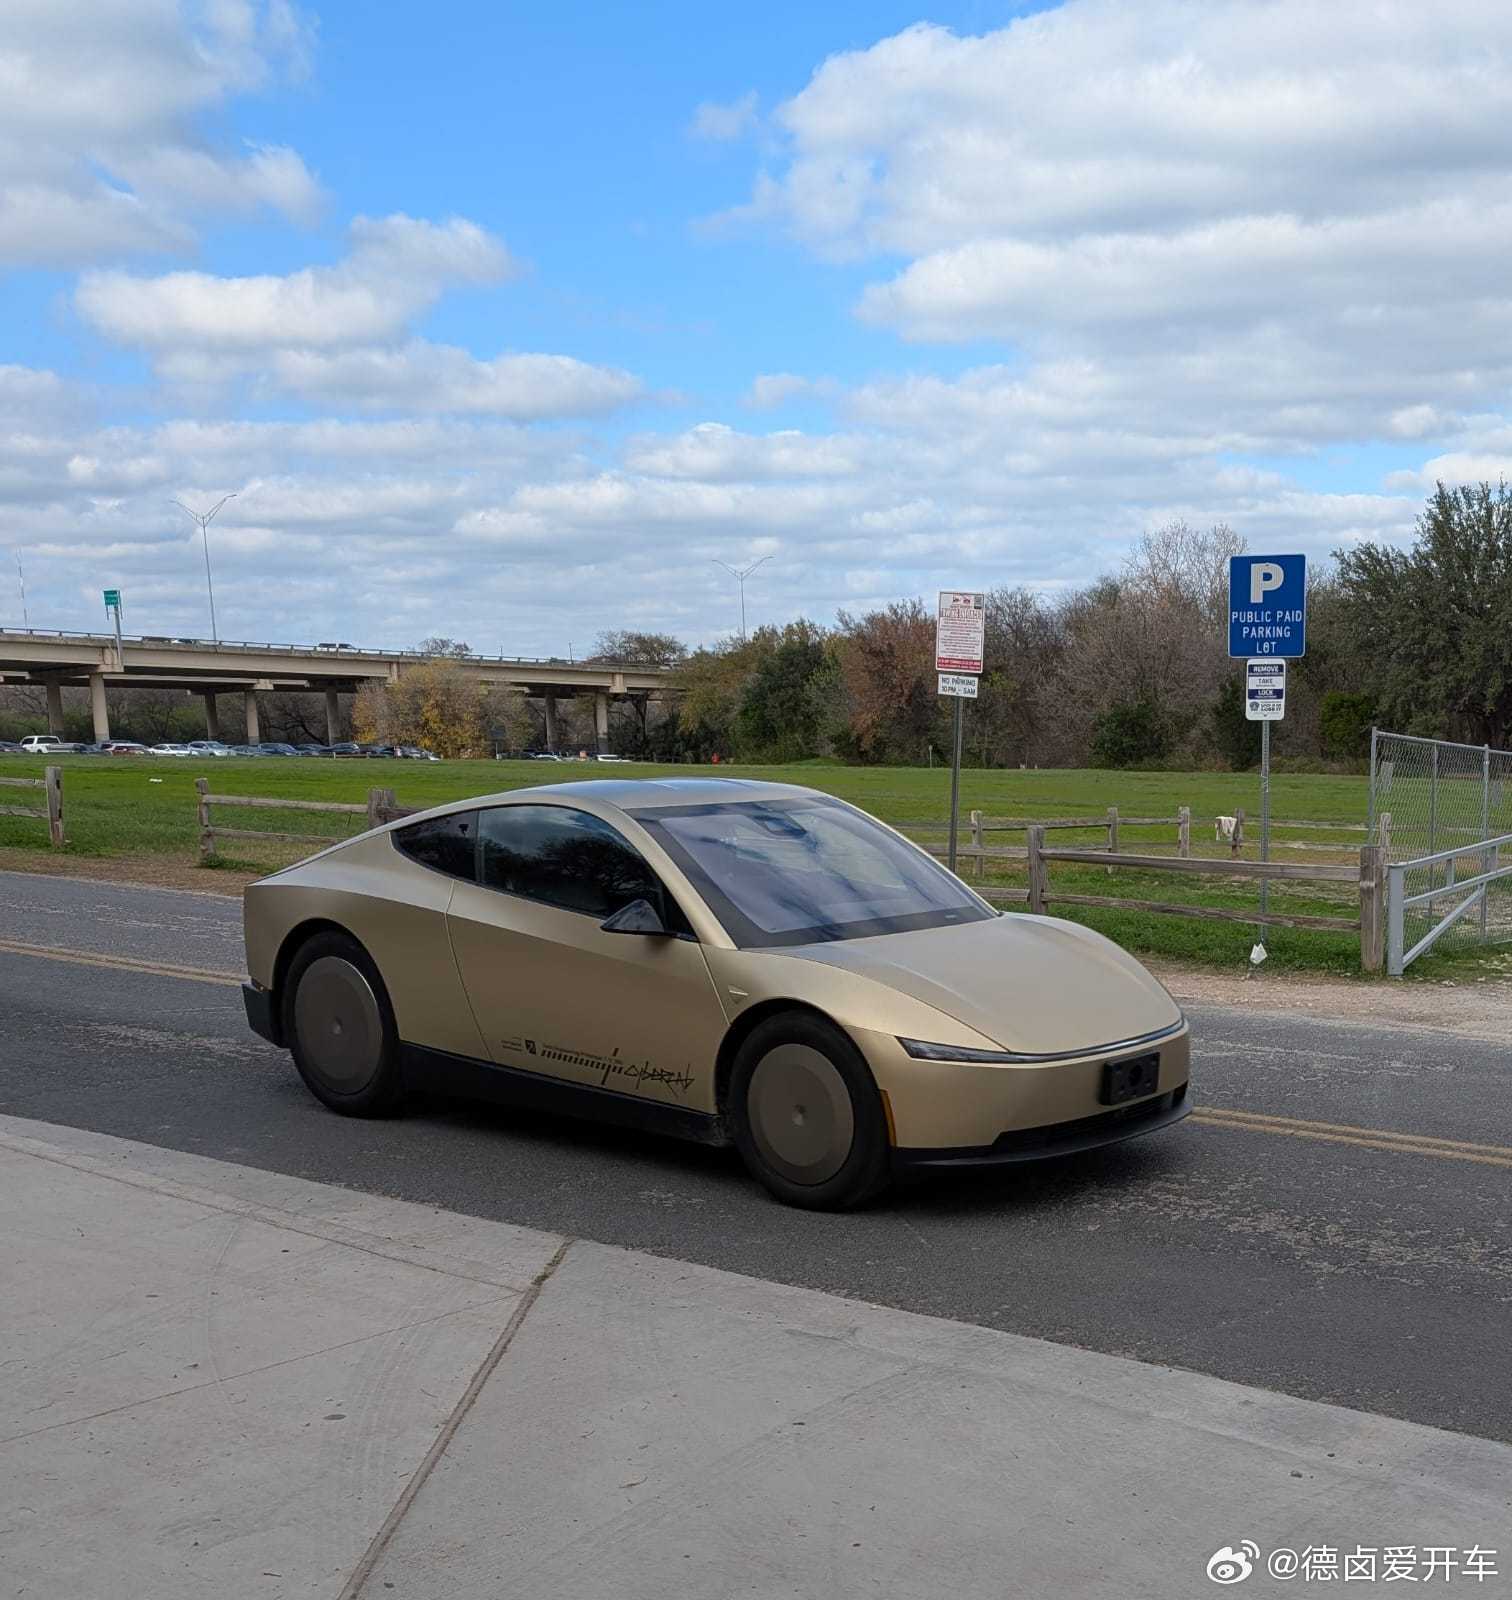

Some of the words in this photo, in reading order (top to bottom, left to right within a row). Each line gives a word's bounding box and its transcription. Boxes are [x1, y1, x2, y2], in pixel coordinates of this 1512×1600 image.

[1250, 562, 1284, 604] P
[1231, 611, 1271, 623] PUBLIC
[1276, 610, 1302, 622] PAID
[1242, 626, 1291, 638] PARKING
[1256, 641, 1276, 654] LOT
[951, 678, 976, 687] PARKING
